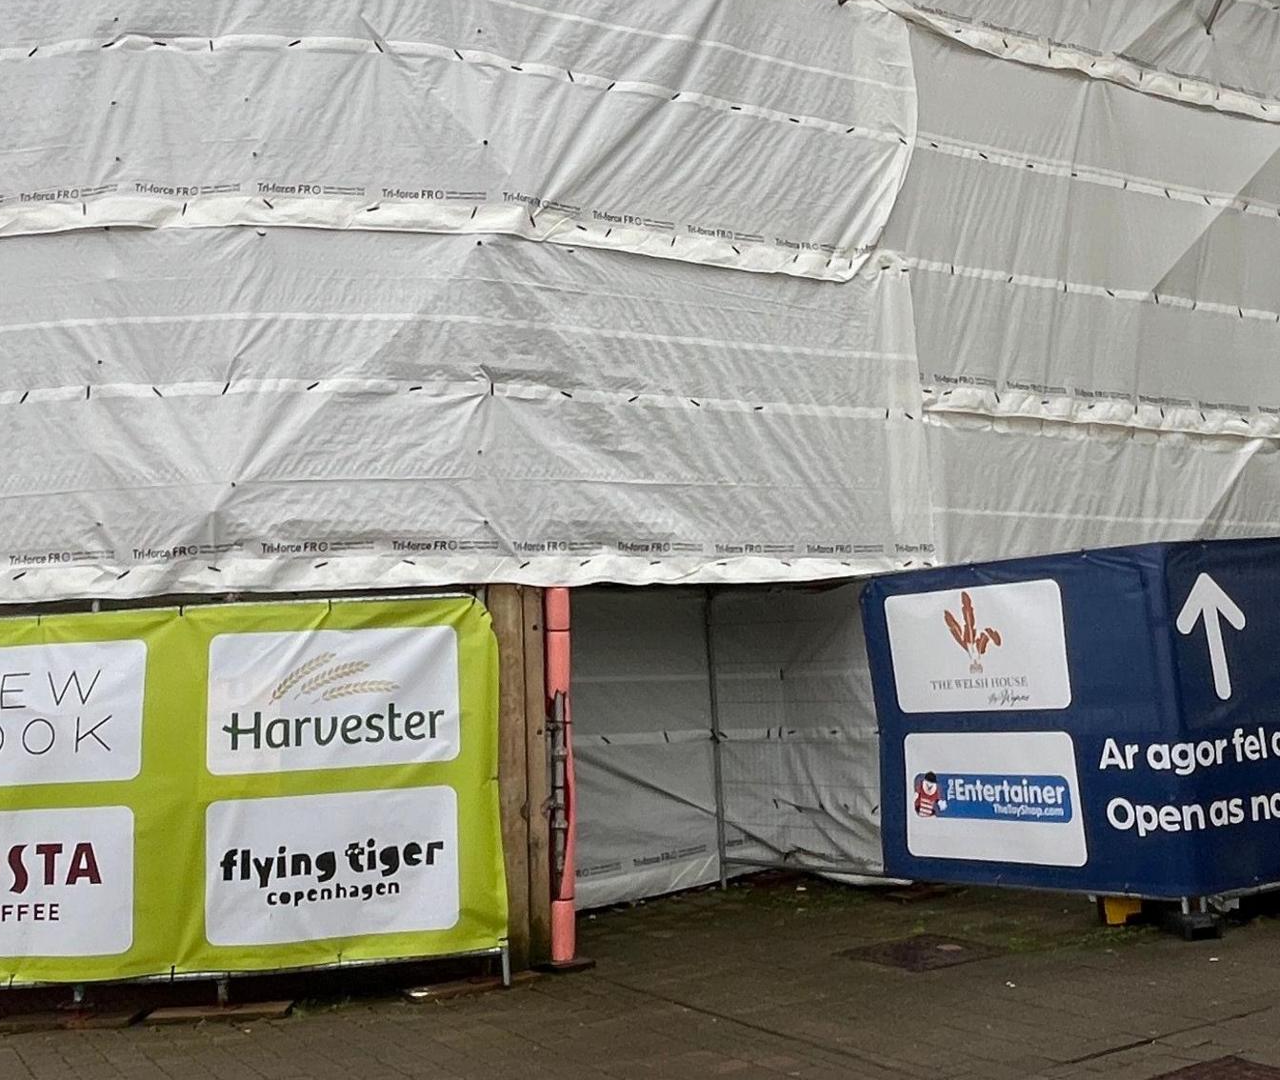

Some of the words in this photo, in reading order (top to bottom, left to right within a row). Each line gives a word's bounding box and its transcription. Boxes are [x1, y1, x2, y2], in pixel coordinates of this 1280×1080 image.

[135, 182, 175, 195] Tri-force
[261, 541, 302, 554] Tri-force
[392, 540, 432, 551] Tri-force
[221, 702, 445, 751] Harvester
[1099, 737, 1139, 770] Ar
[1146, 737, 1228, 776] agor
[1232, 726, 1268, 763] fel
[955, 778, 1065, 805] Entertainer
[1106, 796, 1206, 837] Open
[1209, 796, 1244, 827] as
[220, 845, 337, 889] flying
[344, 837, 444, 877] tiger
[266, 881, 400, 907] copenhagen
